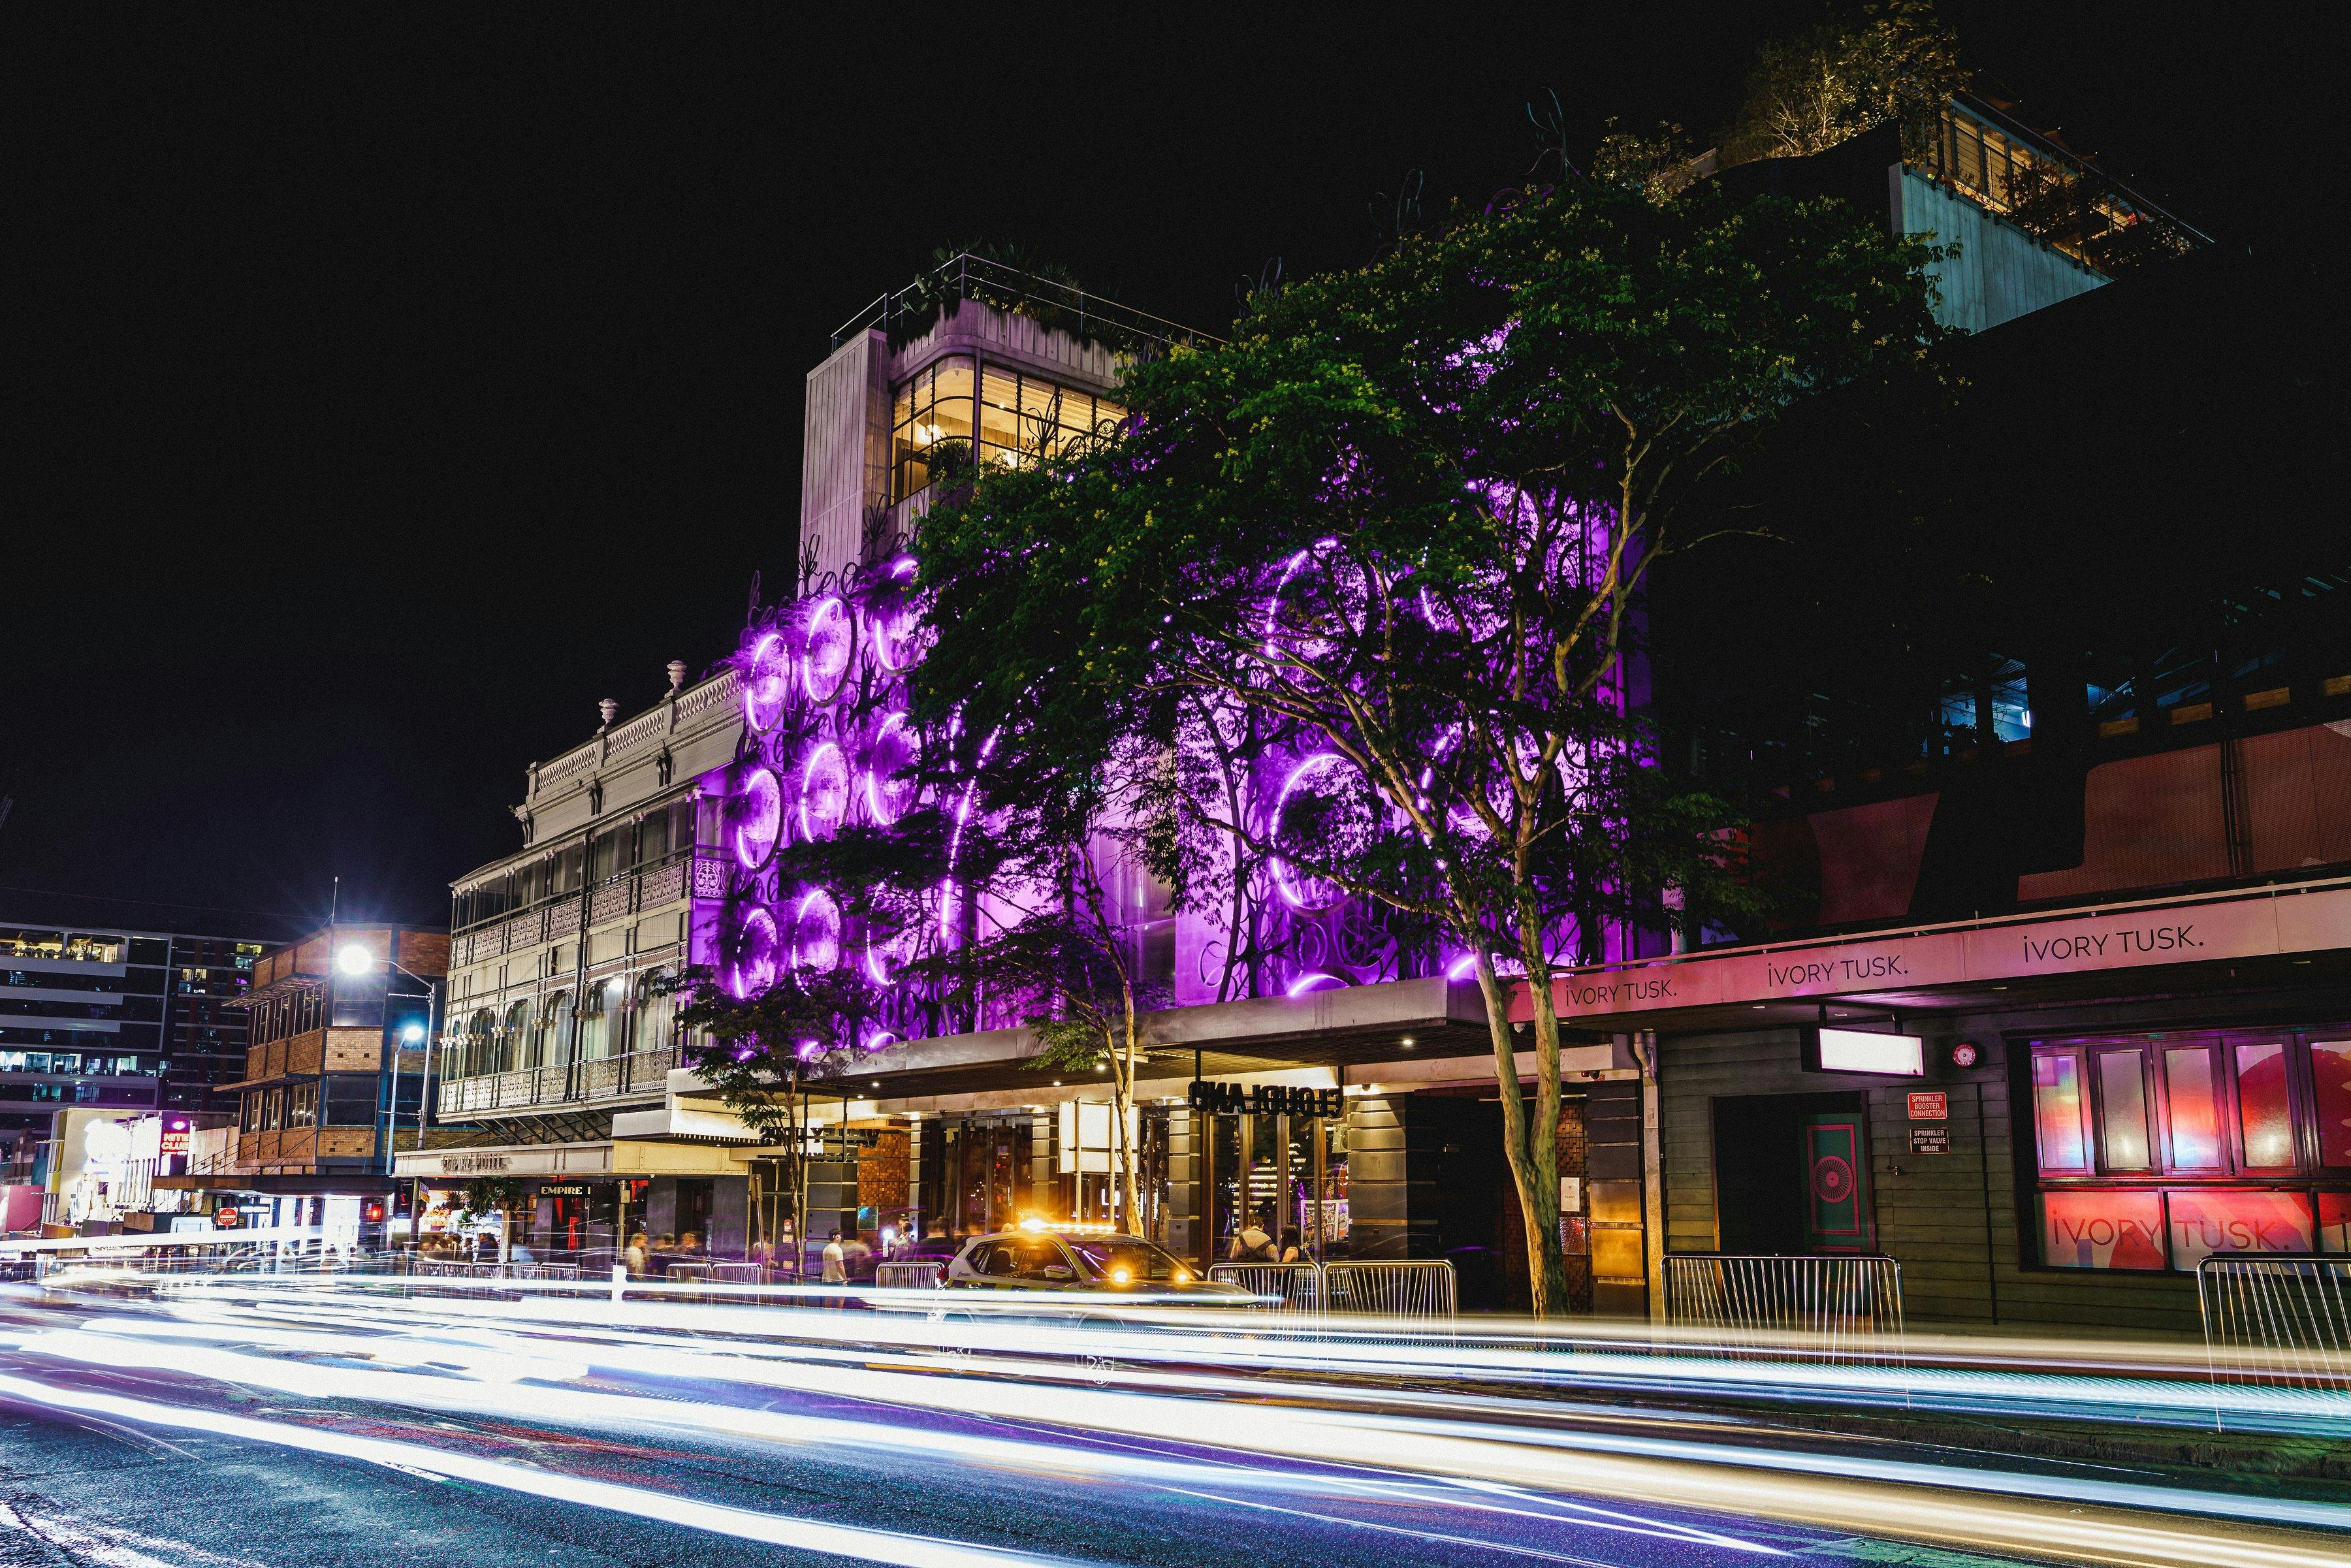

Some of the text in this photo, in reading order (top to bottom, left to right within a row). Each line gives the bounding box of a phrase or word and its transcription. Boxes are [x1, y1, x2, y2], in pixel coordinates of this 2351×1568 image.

[2115, 925, 2204, 953] TUSK.
[1840, 955, 1908, 980] TUSK.
[1623, 980, 1677, 1000] TUSK.
[163, 1133, 189, 1142] NITE
[2173, 1218, 2290, 1251] TUSK.
